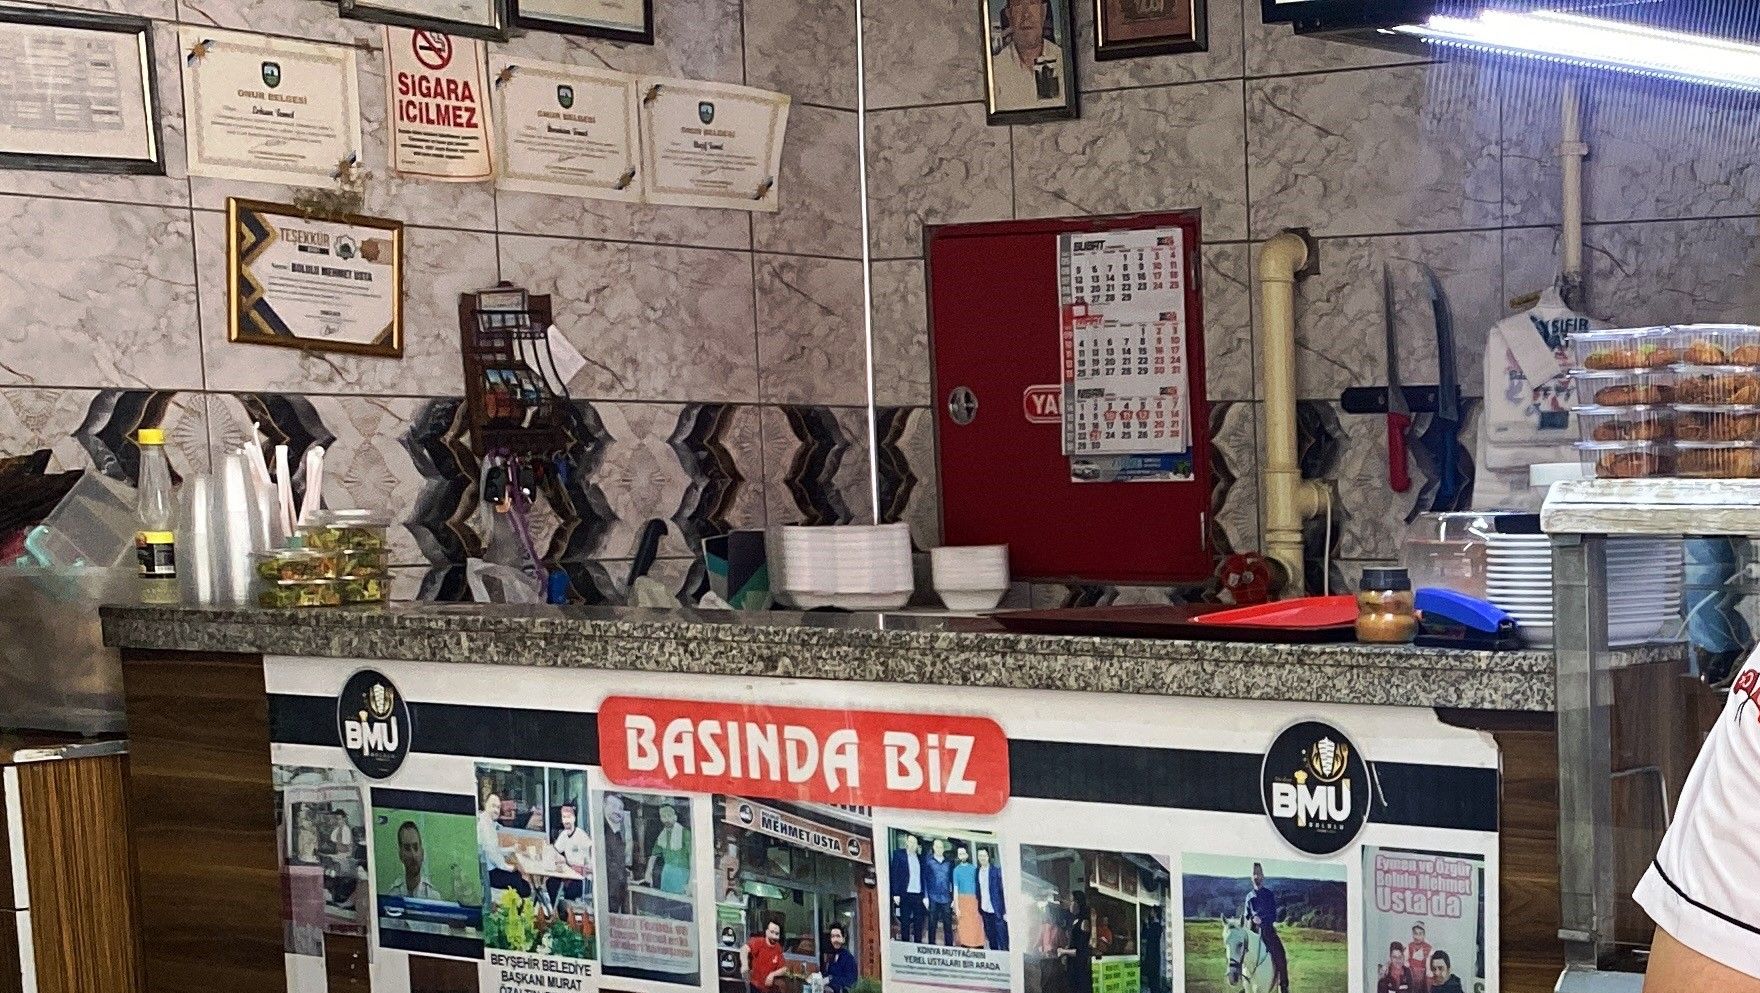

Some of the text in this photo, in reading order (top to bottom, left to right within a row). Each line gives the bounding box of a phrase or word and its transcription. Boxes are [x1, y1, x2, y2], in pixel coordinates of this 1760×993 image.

[624, 713, 861, 794] BASINDA
[762, 816, 841, 852] MEHMET USTA
[1376, 886, 1462, 918] Usta'da
[917, 946, 940, 954] KONYA
[490, 954, 592, 976] BEYŞEHİR BELEDİYE
[904, 956, 927, 964] YEREL
[976, 962, 1000, 970] ARADA
[502, 970, 581, 990] BAŞKANI MURAT
